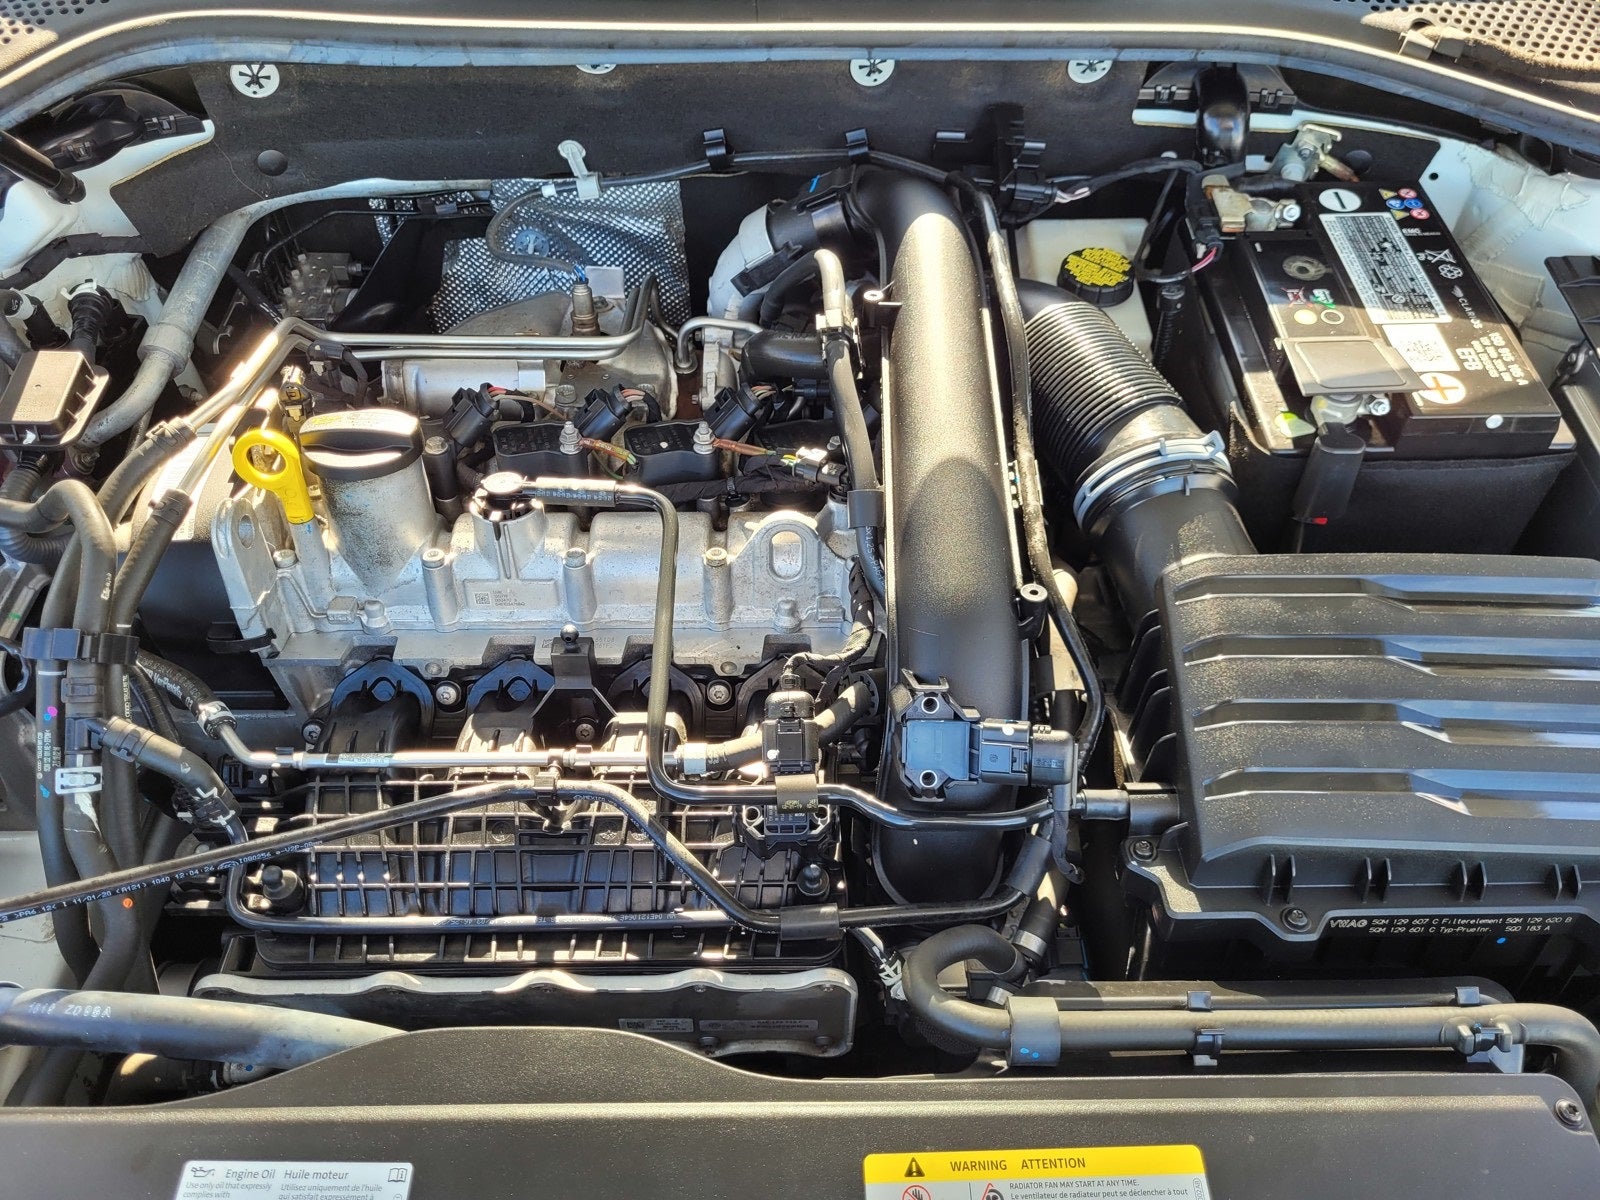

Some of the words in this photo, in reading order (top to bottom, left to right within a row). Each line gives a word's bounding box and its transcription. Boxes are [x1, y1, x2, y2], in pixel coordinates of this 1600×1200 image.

[1456, 348, 1484, 370] EFB
[1329, 919, 1368, 928] VWAG
[950, 1160, 1008, 1172] WARNING
[1021, 1157, 1086, 1170] ATTENTION
[226, 1168, 259, 1181] Engine
[261, 1168, 276, 1179] Oil
[284, 1169, 310, 1179] Huile
[312, 1171, 349, 1179] moteur
[200, 1182, 214, 1190] only
[240, 1182, 272, 1191] expressly
[307, 1184, 350, 1193] uniquement
[1009, 1182, 1043, 1190] RADIATOR
[1044, 1181, 1058, 1189] FAN
[1059, 1180, 1074, 1188] MAY
[1075, 1180, 1095, 1188] START
[1096, 1179, 1105, 1187] AT
[1106, 1179, 1119, 1187] ANY
[1121, 1178, 1140, 1187] TIME.
[183, 1192, 213, 1200] complies
[1020, 1192, 1058, 1200] ventilateur
[1069, 1190, 1101, 1199] radiateur
[1102, 1190, 1118, 1198] peut
[1167, 1188, 1172, 1196] à
[1173, 1188, 1188, 1196] tout
